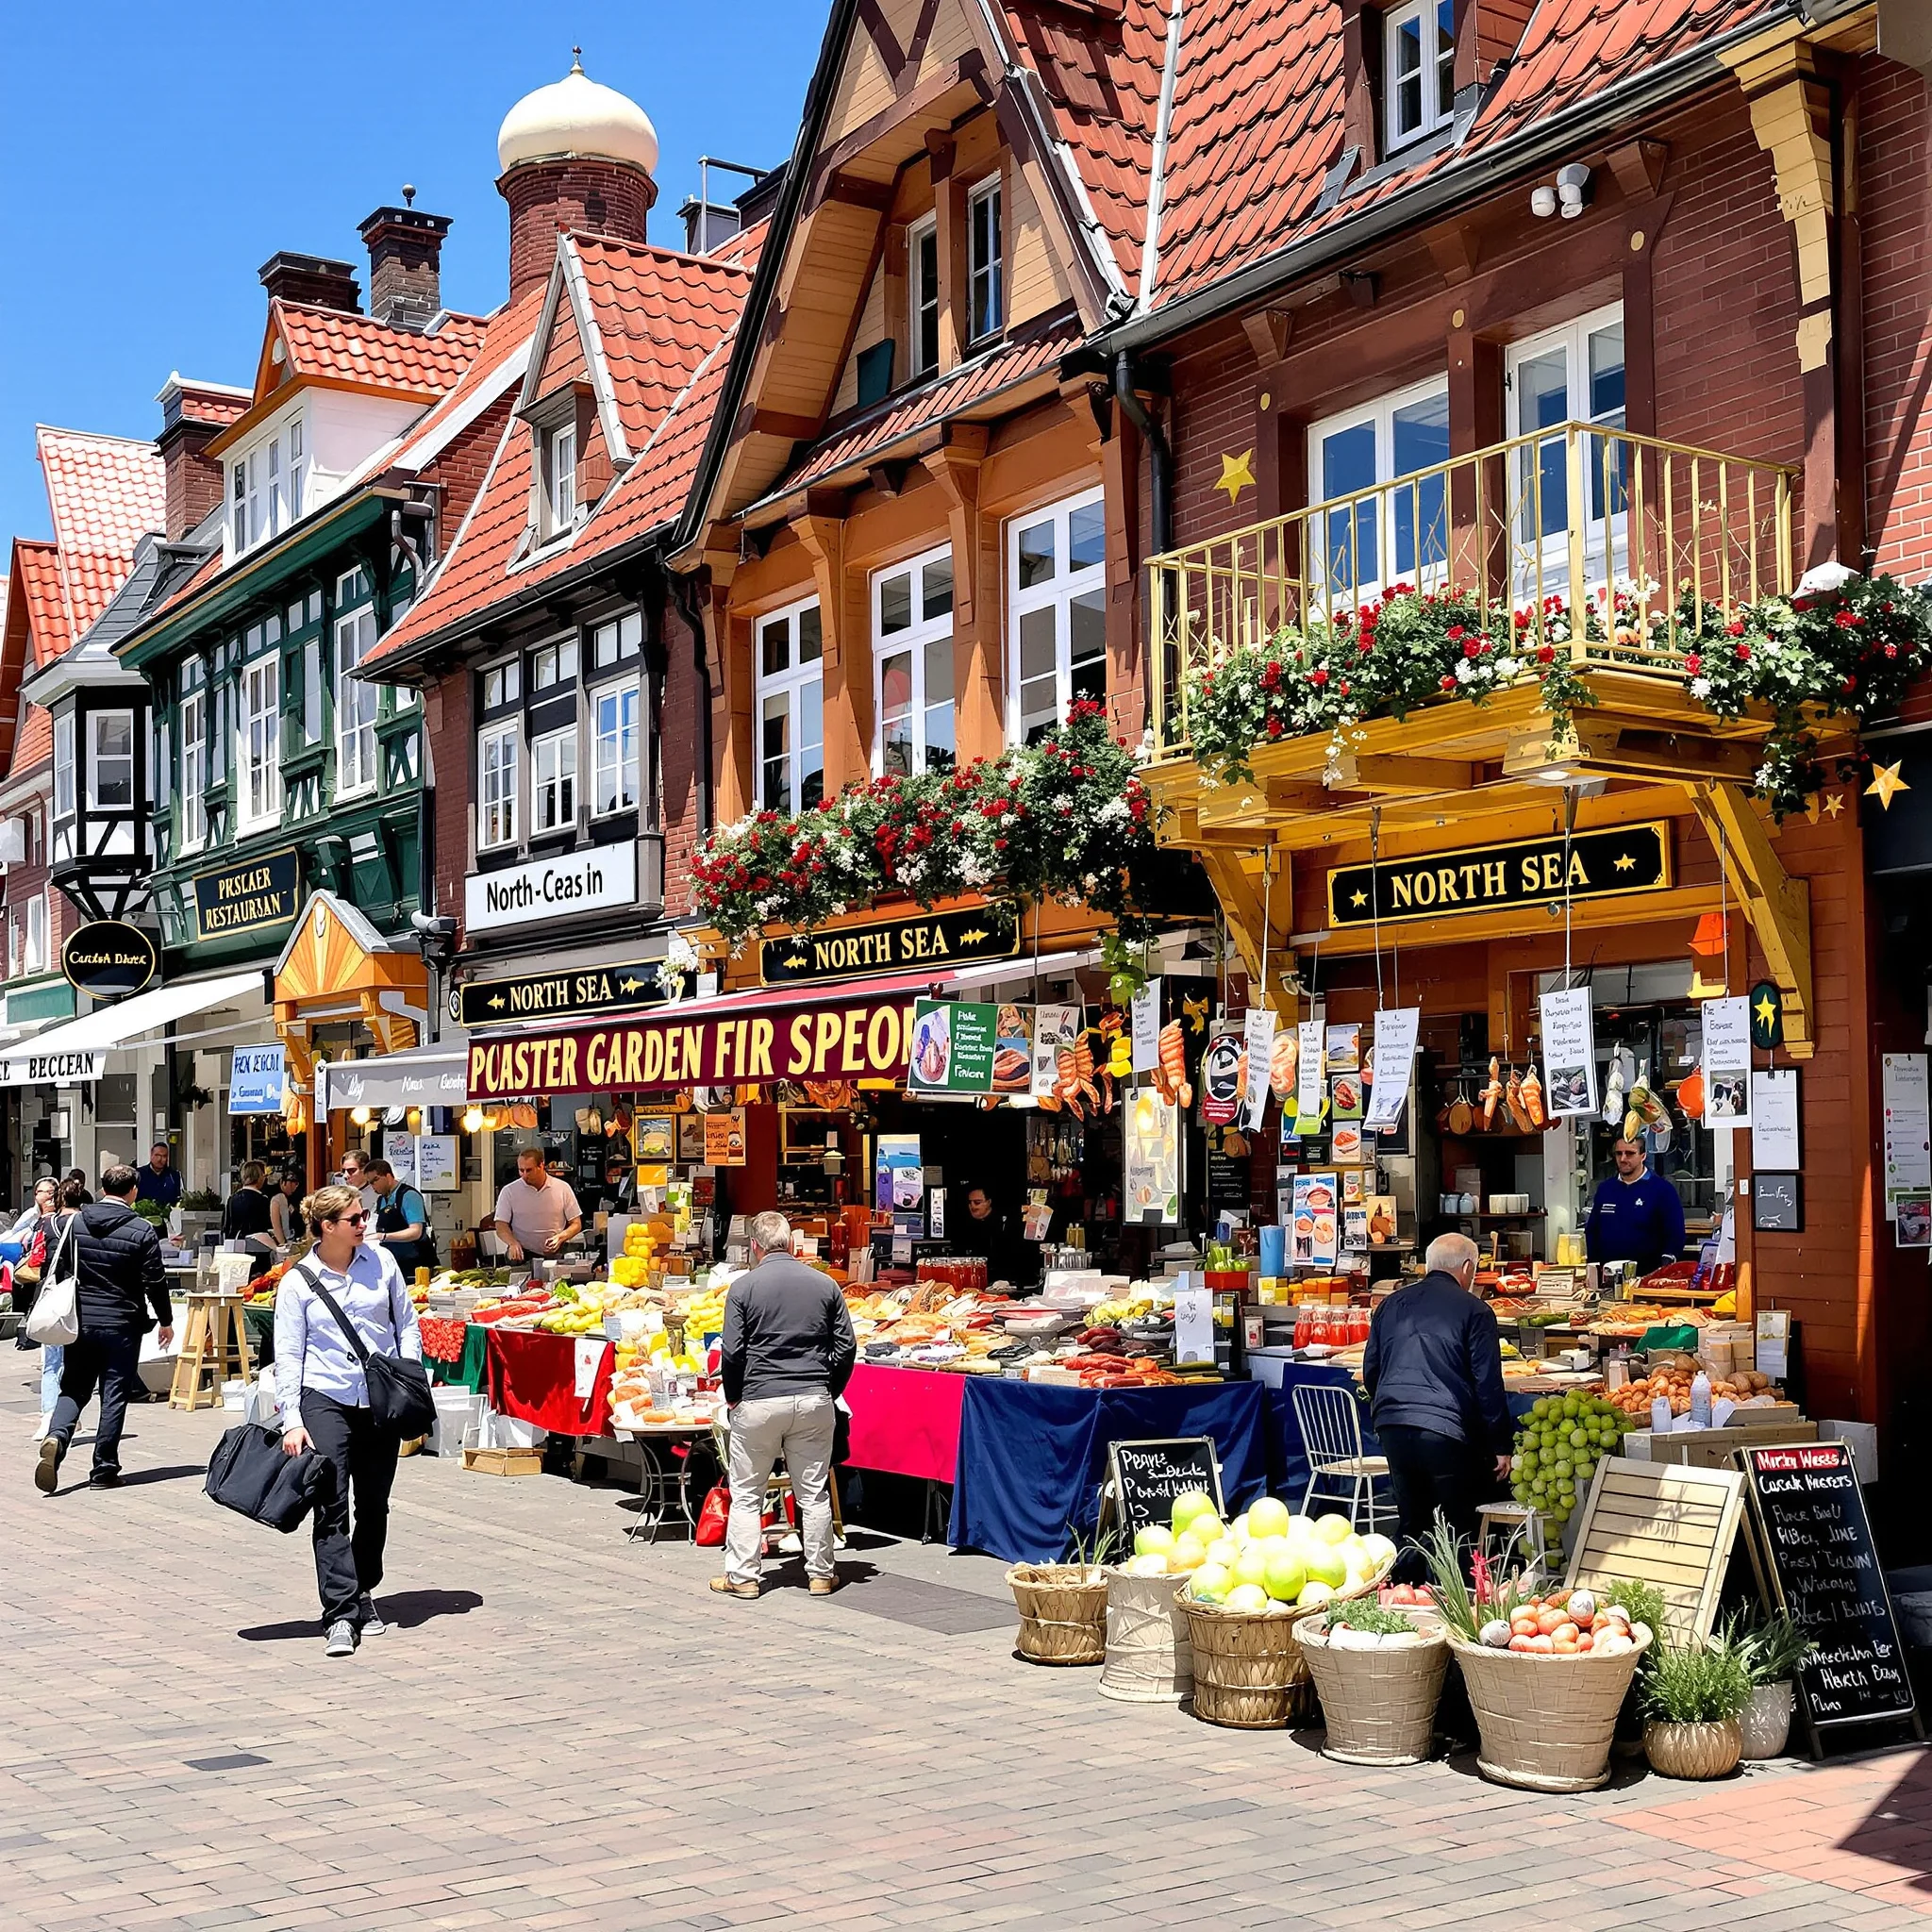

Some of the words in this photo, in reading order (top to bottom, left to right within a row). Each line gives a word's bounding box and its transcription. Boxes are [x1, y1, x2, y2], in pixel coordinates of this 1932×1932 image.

[1391, 860, 1507, 908] NORTH
[1522, 850, 1591, 892] SEA
[813, 932, 891, 970] NORTH
[900, 924, 950, 959] SEA
[509, 979, 570, 1012] NORTH
[575, 974, 614, 1005] SEA
[587, 1024, 706, 1086] GARDEN
[713, 1019, 774, 1078] FIR
